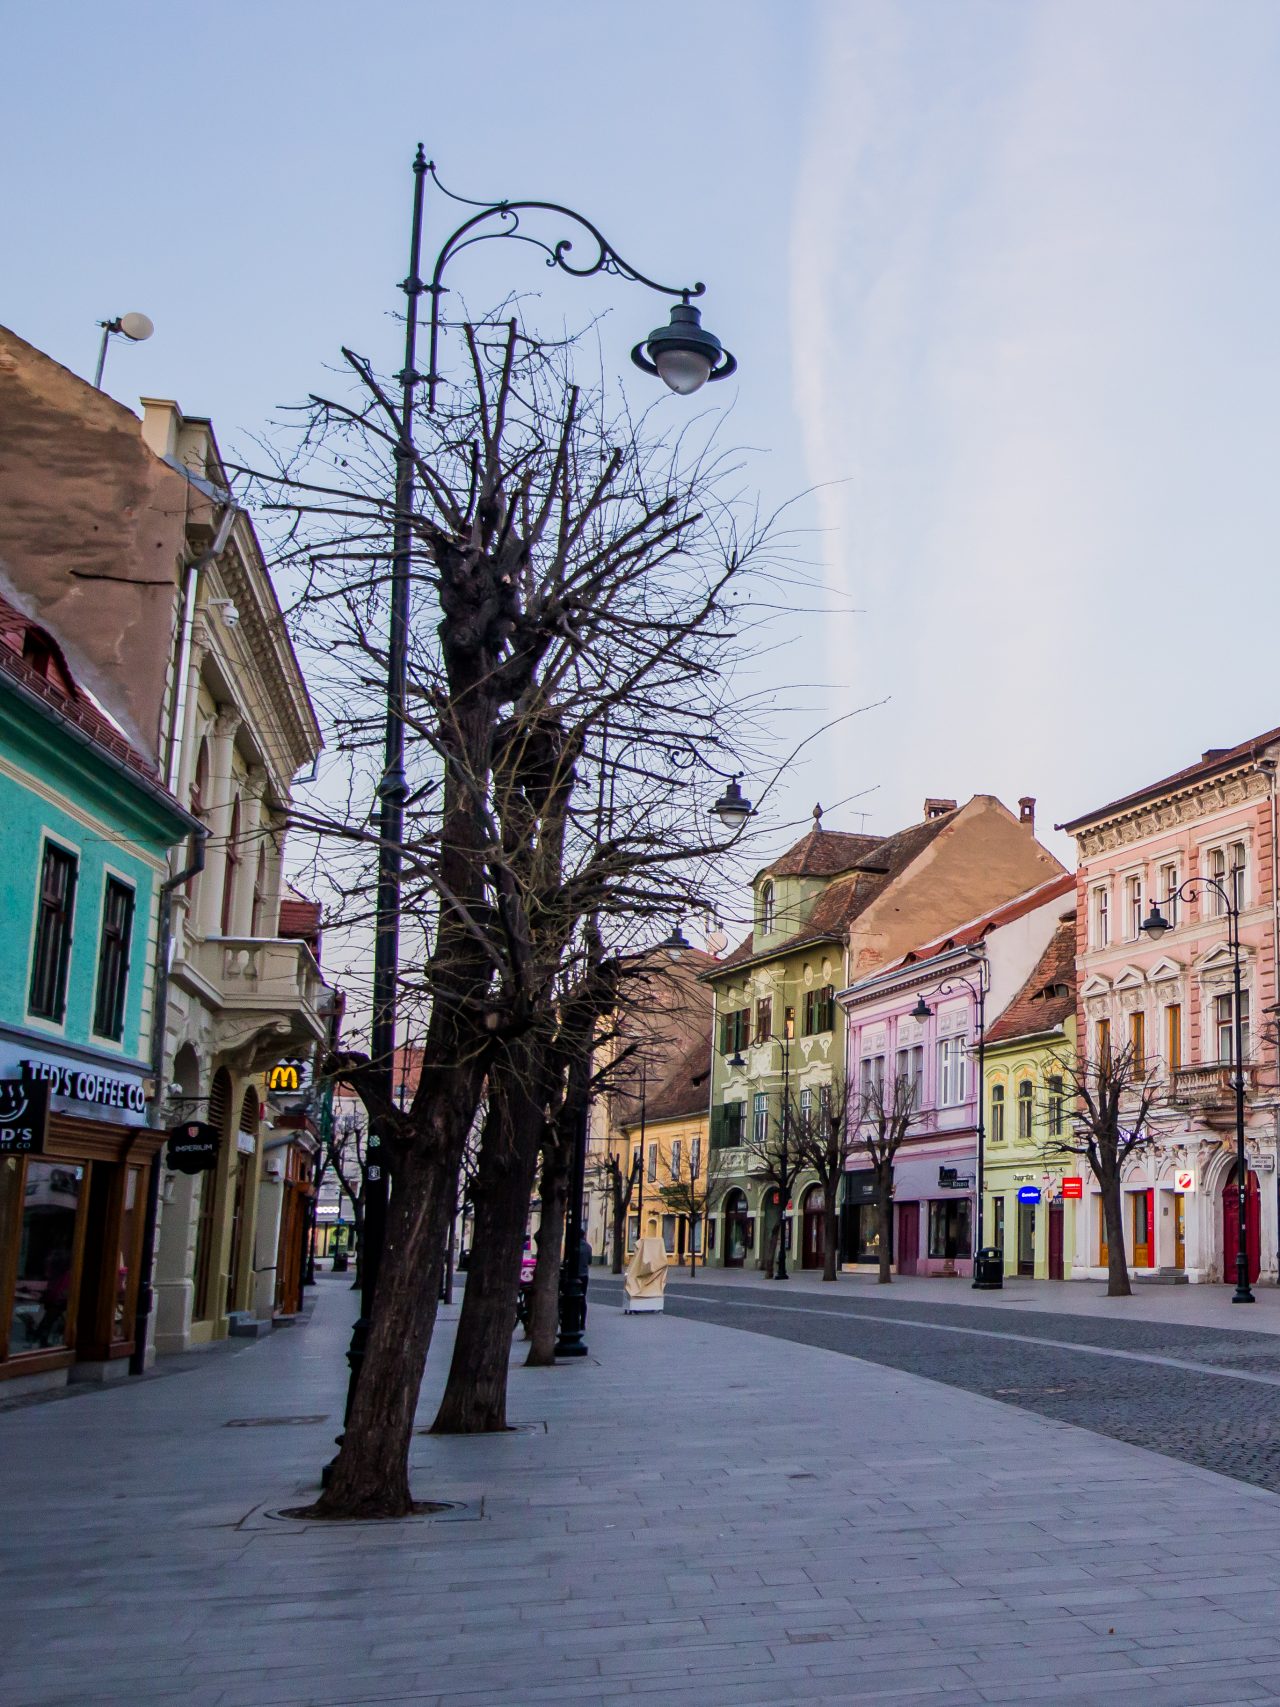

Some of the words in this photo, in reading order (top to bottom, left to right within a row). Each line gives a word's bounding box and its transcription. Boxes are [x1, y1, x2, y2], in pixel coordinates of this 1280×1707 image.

[28, 1060, 74, 1097] TED'S
[77, 1072, 125, 1108] COFFEE
[175, 1143, 213, 1152] IMPERIUM
